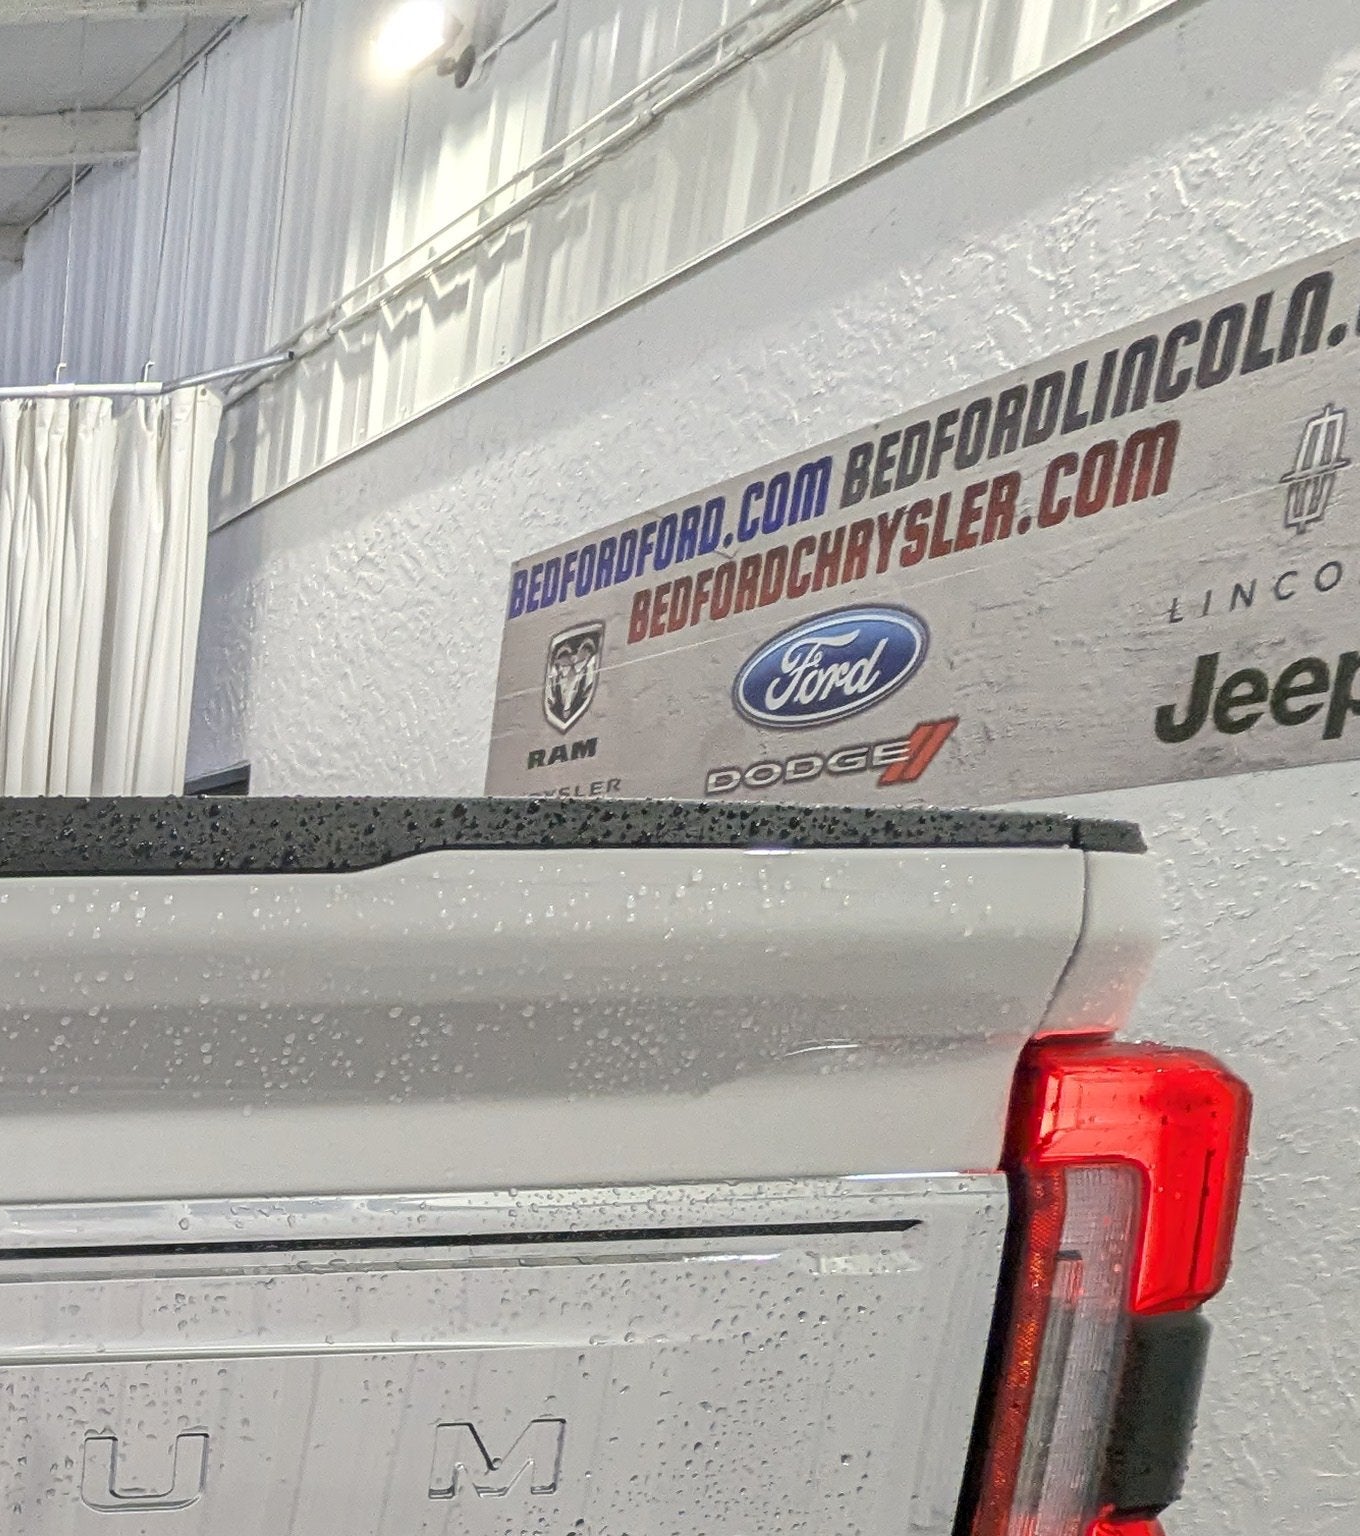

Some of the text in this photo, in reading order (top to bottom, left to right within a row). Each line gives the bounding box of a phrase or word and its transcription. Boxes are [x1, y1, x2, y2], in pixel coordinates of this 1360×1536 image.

[508, 269, 1360, 620] BEDFORDFORD.COM BEDFORDLINCOLN.
[627, 419, 1180, 645] BEDFORDCHRYSLER.COM
[1168, 561, 1360, 624] LINCO
[764, 628, 889, 711] Ford
[527, 737, 598, 770] RAM
[705, 736, 914, 795] DODGE
